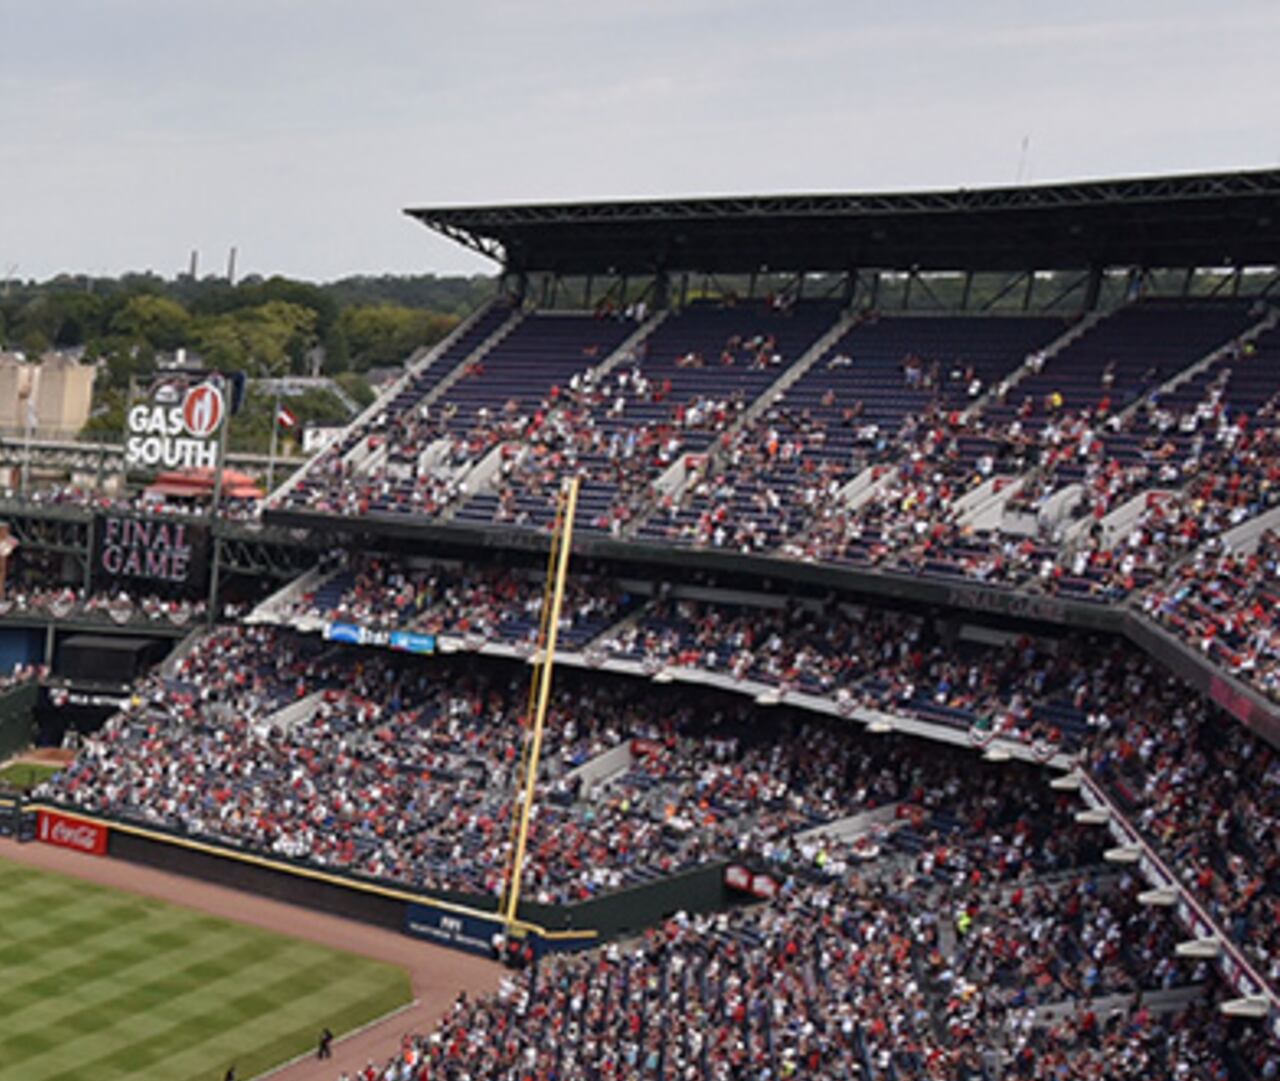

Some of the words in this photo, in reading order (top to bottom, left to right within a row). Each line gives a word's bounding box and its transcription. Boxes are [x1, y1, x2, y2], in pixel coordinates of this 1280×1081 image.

[128, 404, 184, 435] GAS
[125, 436, 218, 469] SOUTH
[104, 518, 192, 553] FINAL
[102, 544, 190, 582] GAME
